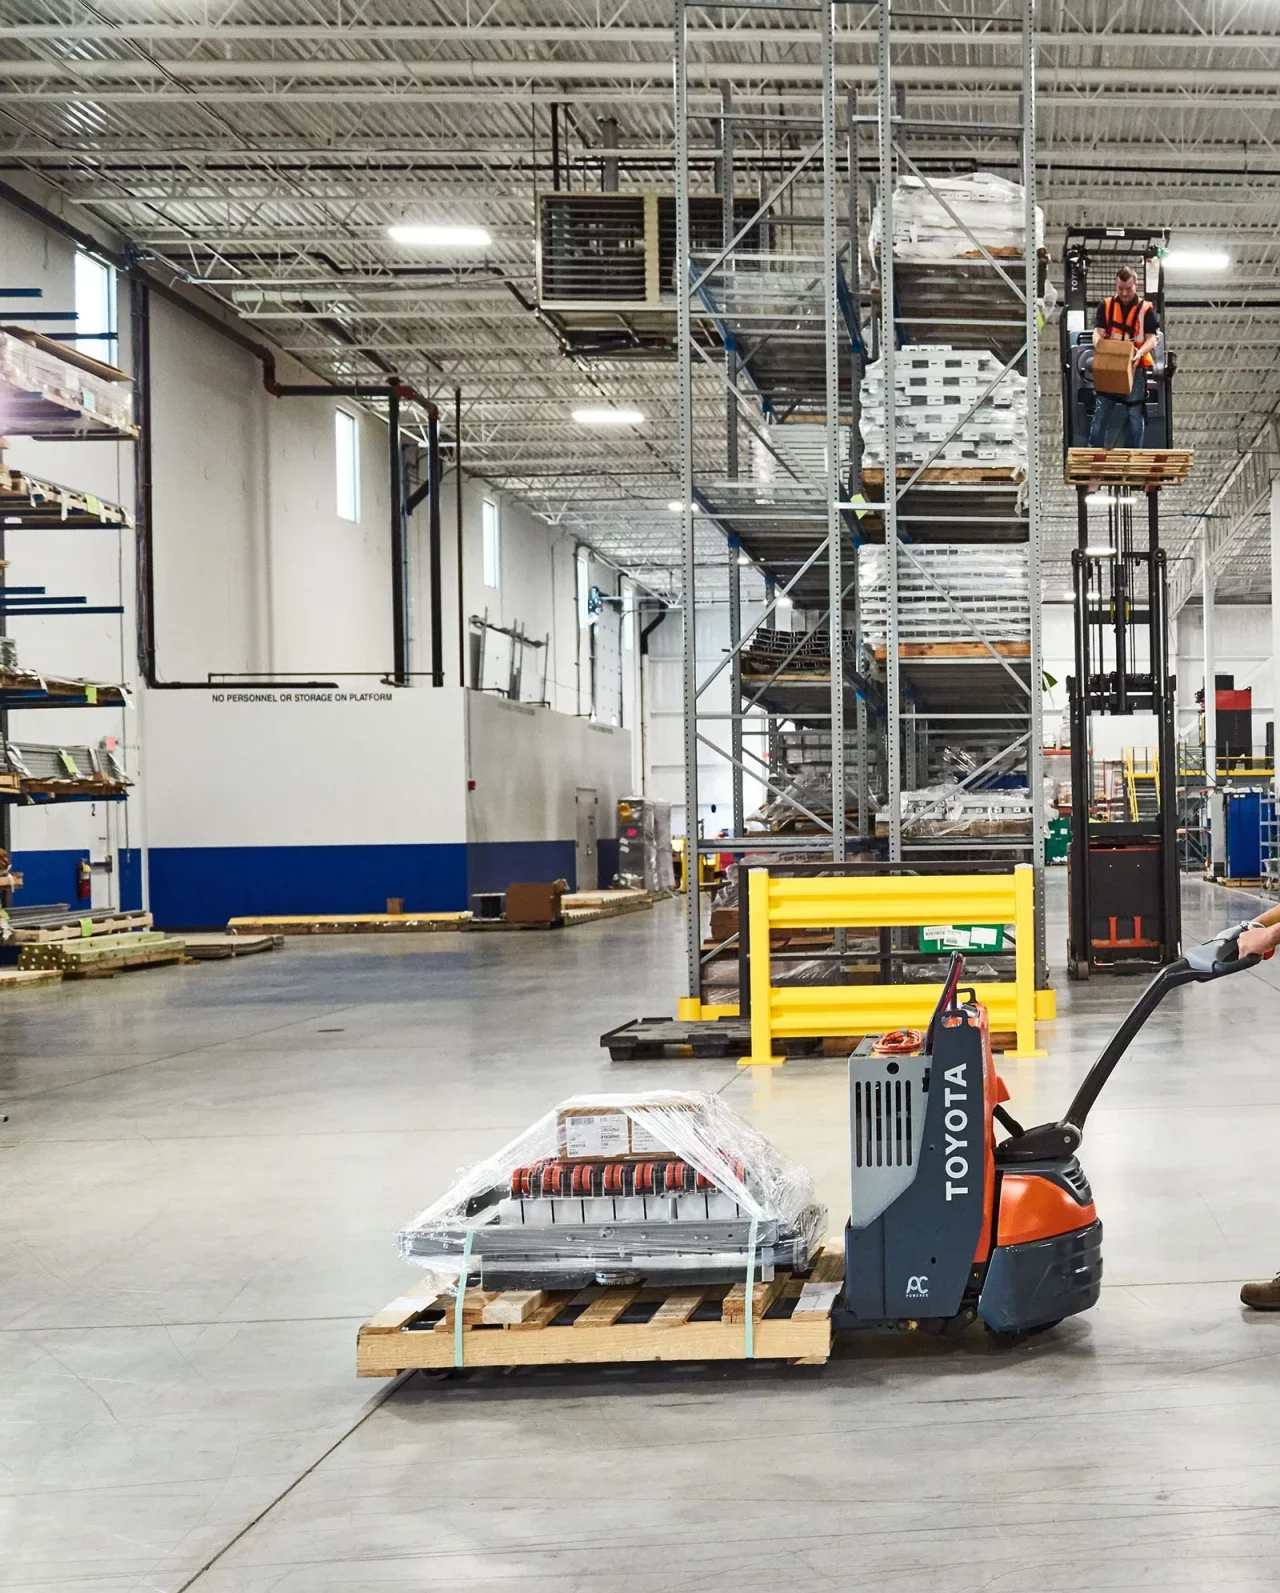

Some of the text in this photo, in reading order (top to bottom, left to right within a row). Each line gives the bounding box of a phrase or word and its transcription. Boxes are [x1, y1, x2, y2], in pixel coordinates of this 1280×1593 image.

[212, 693, 393, 702] NO PERSONNEL OR STORAGE ON PLATFORM
[944, 1062, 969, 1201] TOYOTA
[906, 1275, 928, 1294] AC
